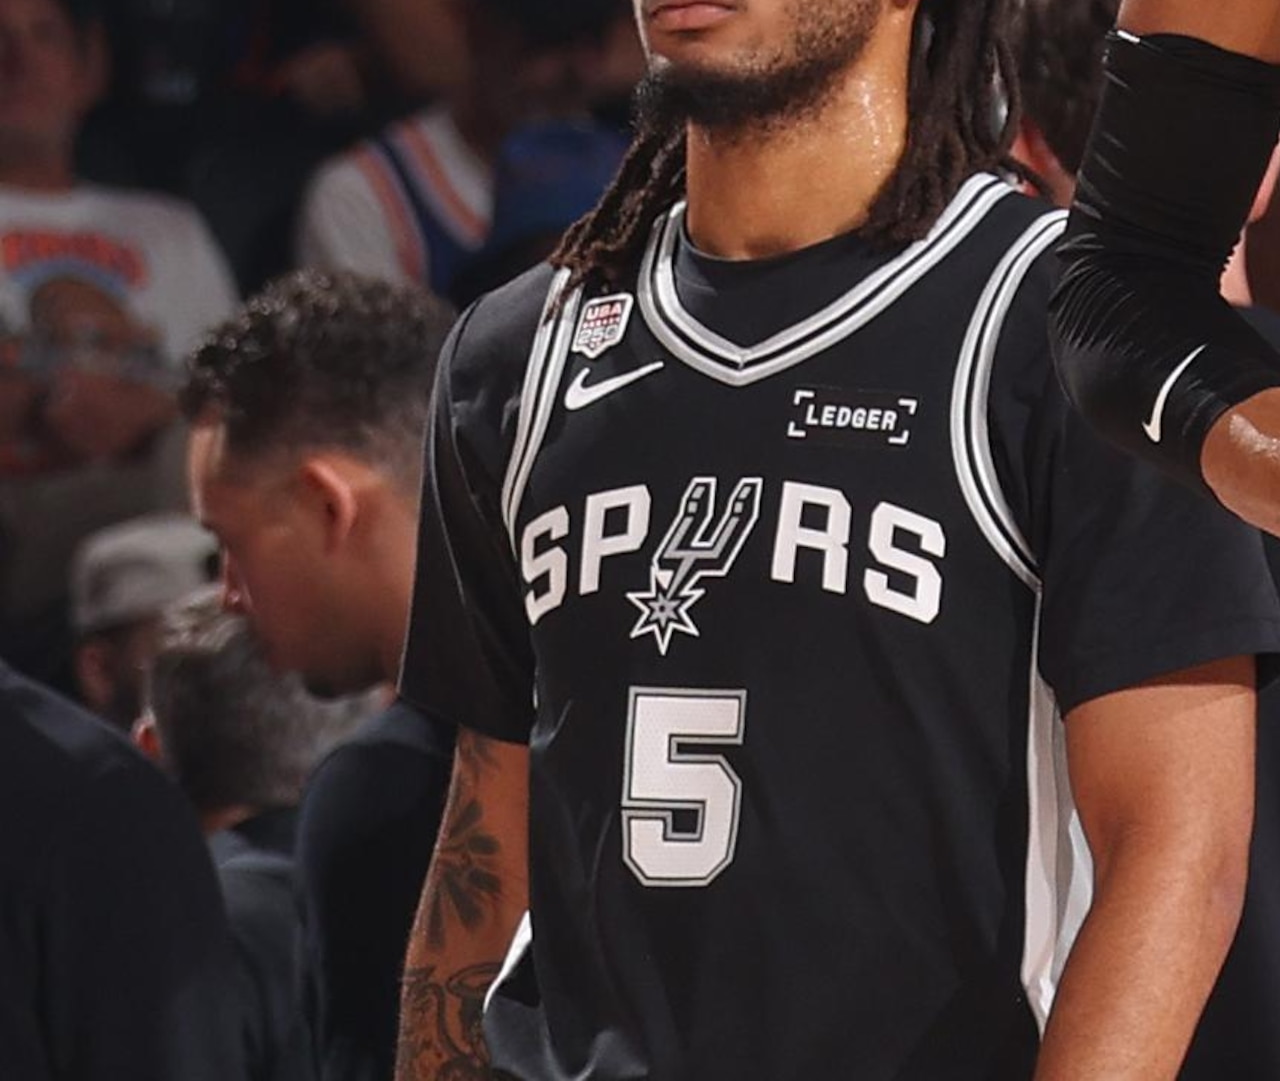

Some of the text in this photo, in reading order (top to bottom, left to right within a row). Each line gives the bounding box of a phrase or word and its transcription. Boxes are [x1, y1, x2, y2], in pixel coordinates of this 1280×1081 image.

[586, 302, 621, 320] USA
[805, 404, 899, 431] LEDGER
[521, 477, 946, 655] SPURS
[621, 686, 747, 886] 5
